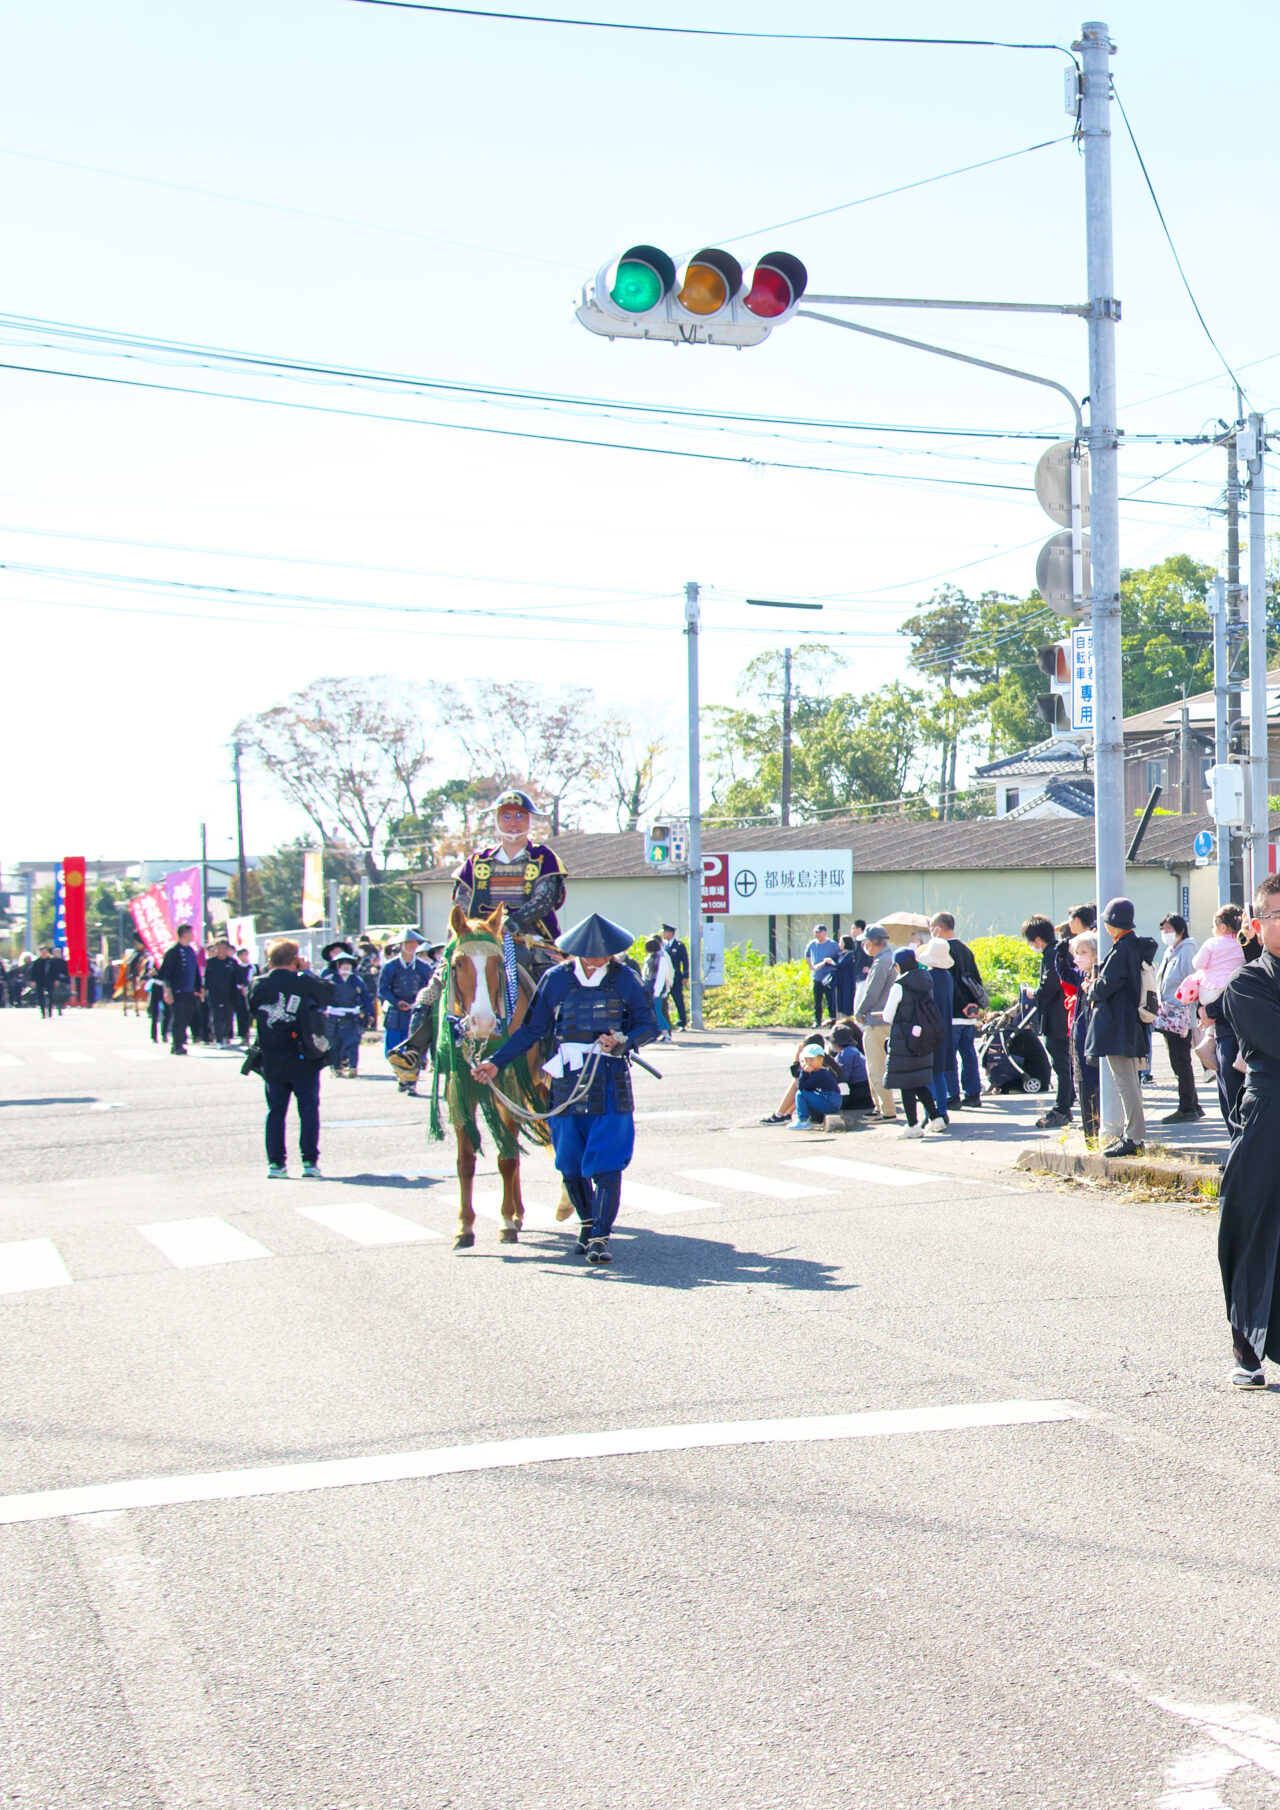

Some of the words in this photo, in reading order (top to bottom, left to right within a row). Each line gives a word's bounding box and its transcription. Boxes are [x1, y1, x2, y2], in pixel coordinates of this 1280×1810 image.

[1076, 636, 1085, 680] 自転車
[1080, 685, 1093, 723] 専用
[701, 855, 723, 886] P
[763, 869, 845, 889] 都城島津邸
